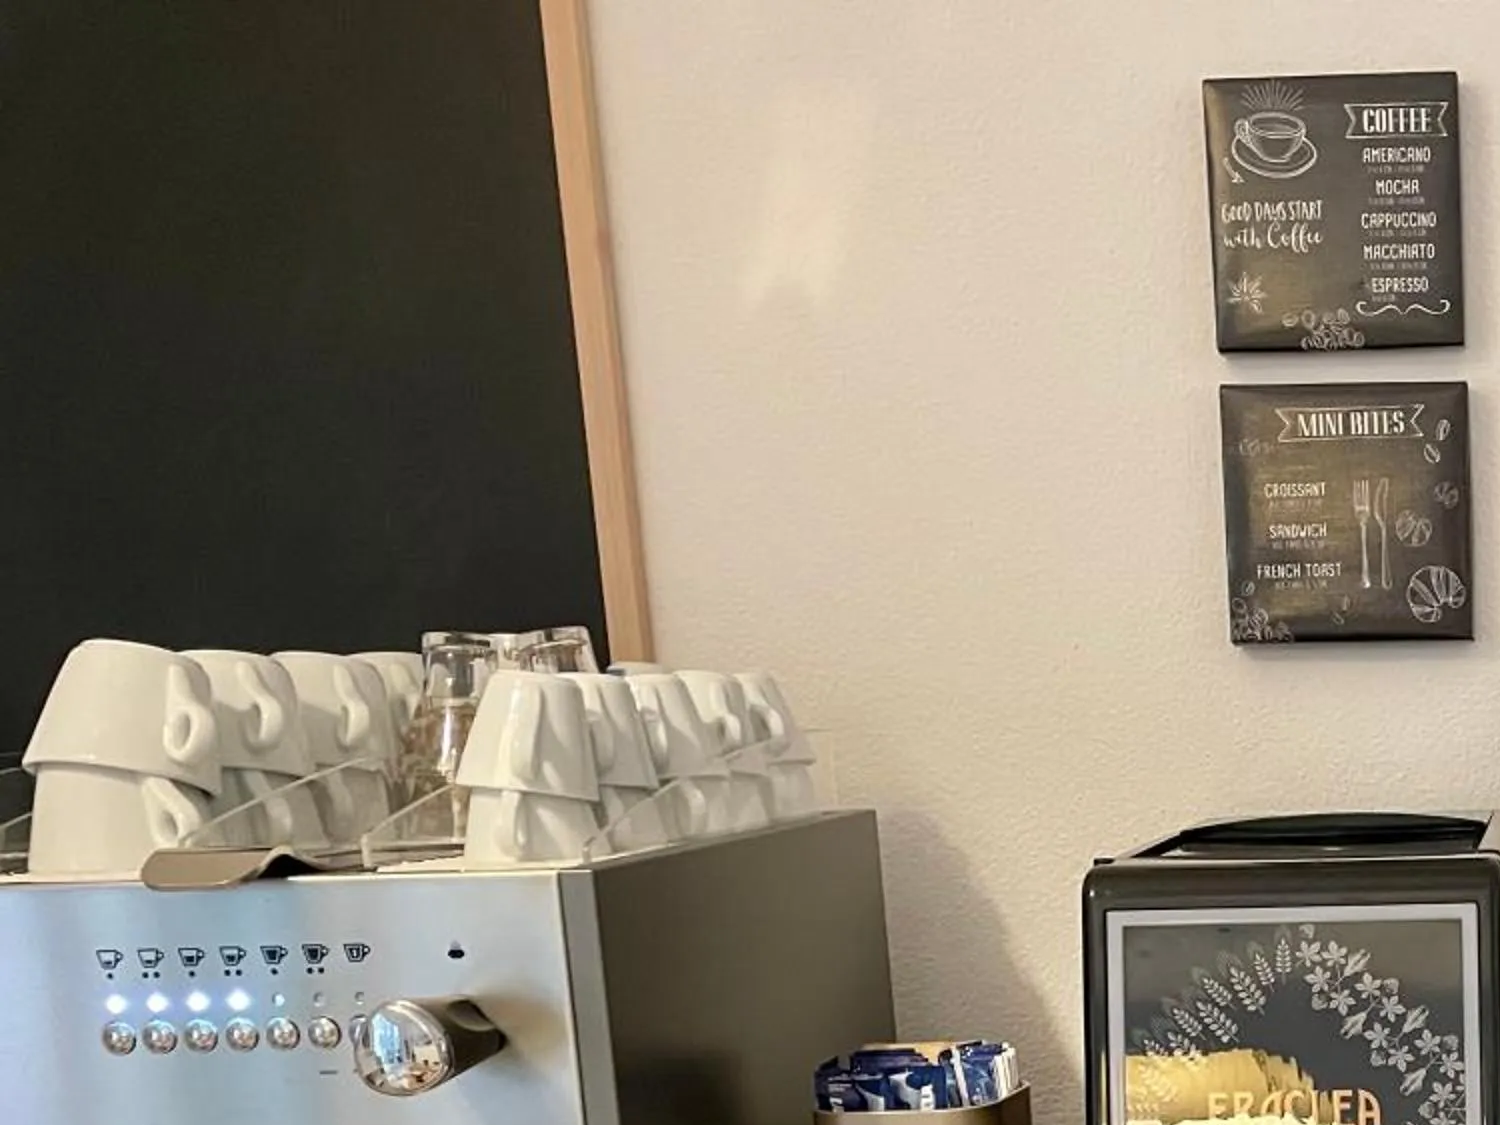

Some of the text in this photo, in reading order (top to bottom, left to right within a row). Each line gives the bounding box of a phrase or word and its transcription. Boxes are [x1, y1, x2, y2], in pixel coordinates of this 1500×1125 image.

[1362, 107, 1431, 133] COFFEE
[1363, 146, 1431, 162] AMERICANO
[1375, 179, 1419, 195] MOCHA
[1221, 200, 1322, 223] GOOD DAYS START
[1361, 211, 1437, 228] CAPPUCCINO
[1223, 221, 1324, 253] with Coffee
[1363, 243, 1435, 259] MACCHIATO
[1371, 276, 1429, 293] ESPRESSO
[1298, 410, 1406, 437] MINI BITES
[1264, 482, 1326, 498] CROISSANT
[1270, 522, 1327, 539] SANDWICH
[1257, 562, 1342, 580] FRENCH TOAST
